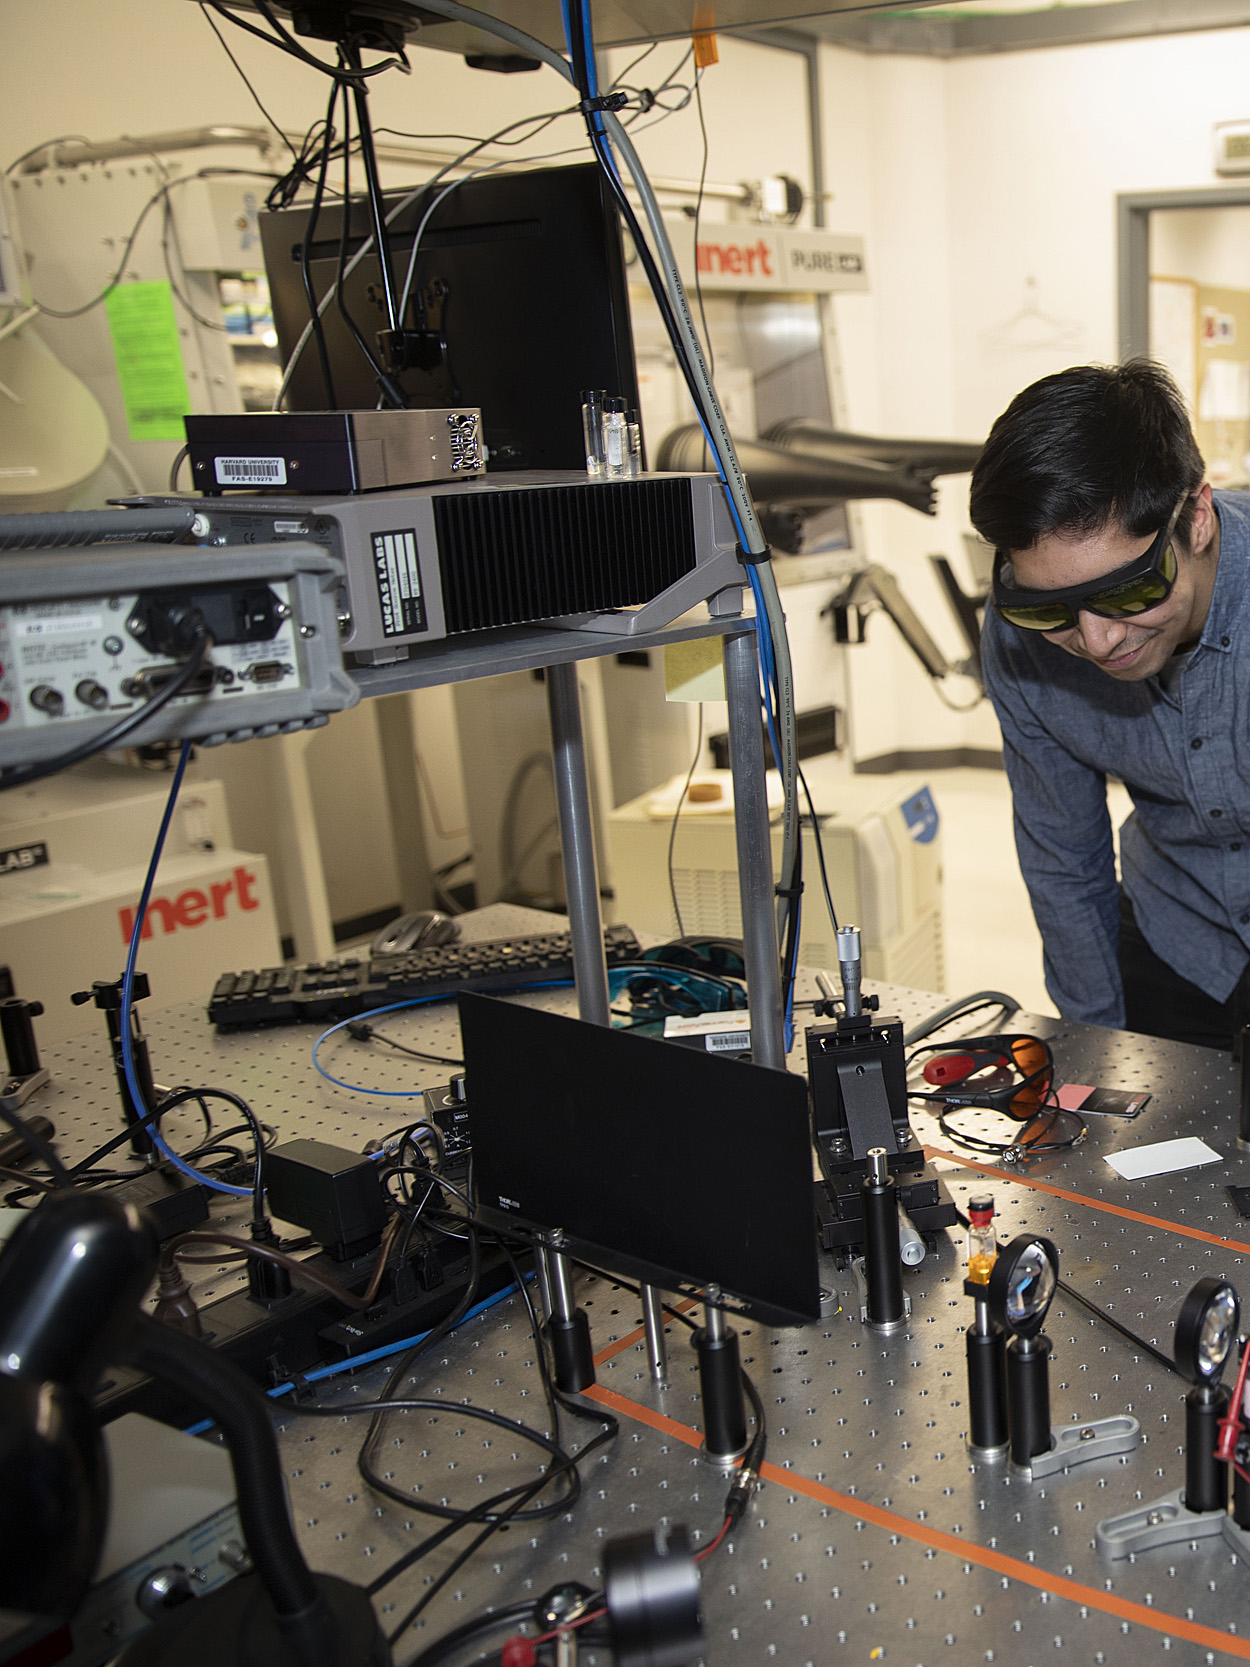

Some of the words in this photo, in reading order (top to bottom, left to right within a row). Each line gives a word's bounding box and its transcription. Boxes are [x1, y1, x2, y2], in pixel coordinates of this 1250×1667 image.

[698, 358, 709, 386] MADISON
[707, 386, 716, 404] CABLE
[374, 536, 387, 580] LABS
[380, 582, 394, 634] LUCAS
[118, 866, 260, 947] inert
